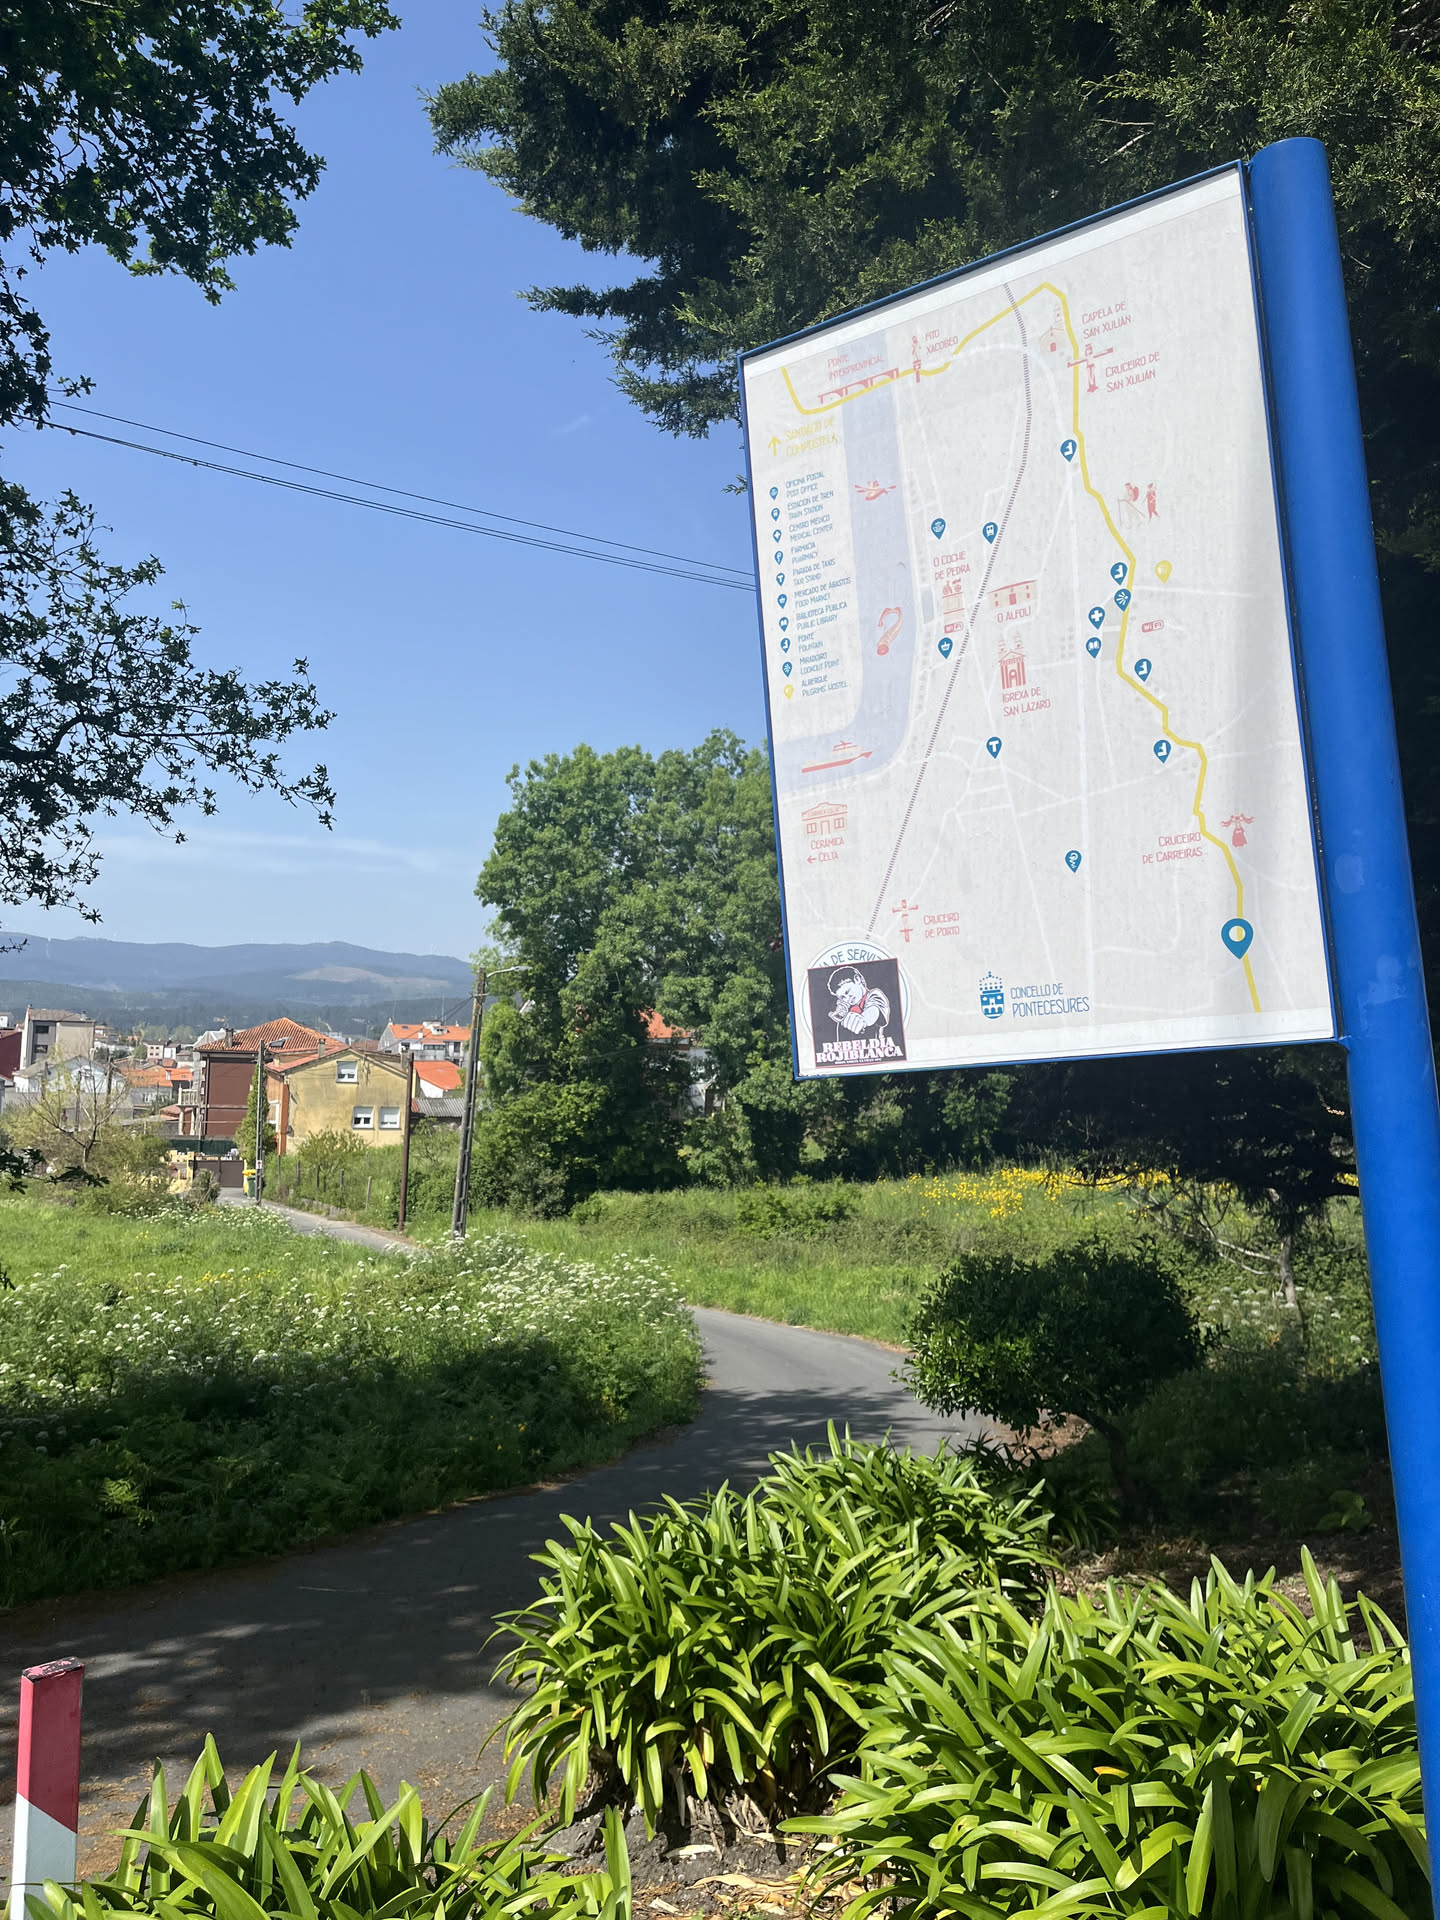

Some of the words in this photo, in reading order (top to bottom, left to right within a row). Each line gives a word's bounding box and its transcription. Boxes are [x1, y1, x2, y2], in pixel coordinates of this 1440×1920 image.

[1081, 305, 1113, 325] CAPELA
[1114, 301, 1126, 313] DE
[1083, 326, 1100, 340] SAN
[926, 336, 959, 355] XACOBEO
[1105, 356, 1147, 378] CRUCEIRO
[1148, 351, 1160, 364] DE
[1106, 378, 1124, 393] SAN
[935, 570, 944, 580] DE
[947, 563, 970, 577] PEDRA
[1031, 687, 1041, 697] DE
[1003, 705, 1019, 716] SAN
[1158, 832, 1202, 847] CRUCEIRO
[819, 851, 839, 862] CELTA
[1155, 847, 1203, 863] CARREIRAS
[923, 912, 960, 925] CRUCEIRO
[924, 929, 935, 939] DE
[936, 926, 960, 937] PORTO
[1010, 984, 1051, 1000] CONCELLO
[1052, 983, 1064, 995] DE
[1012, 996, 1090, 1018] PONTECESURES
[816, 1045, 904, 1063] ROJIBLANCA
